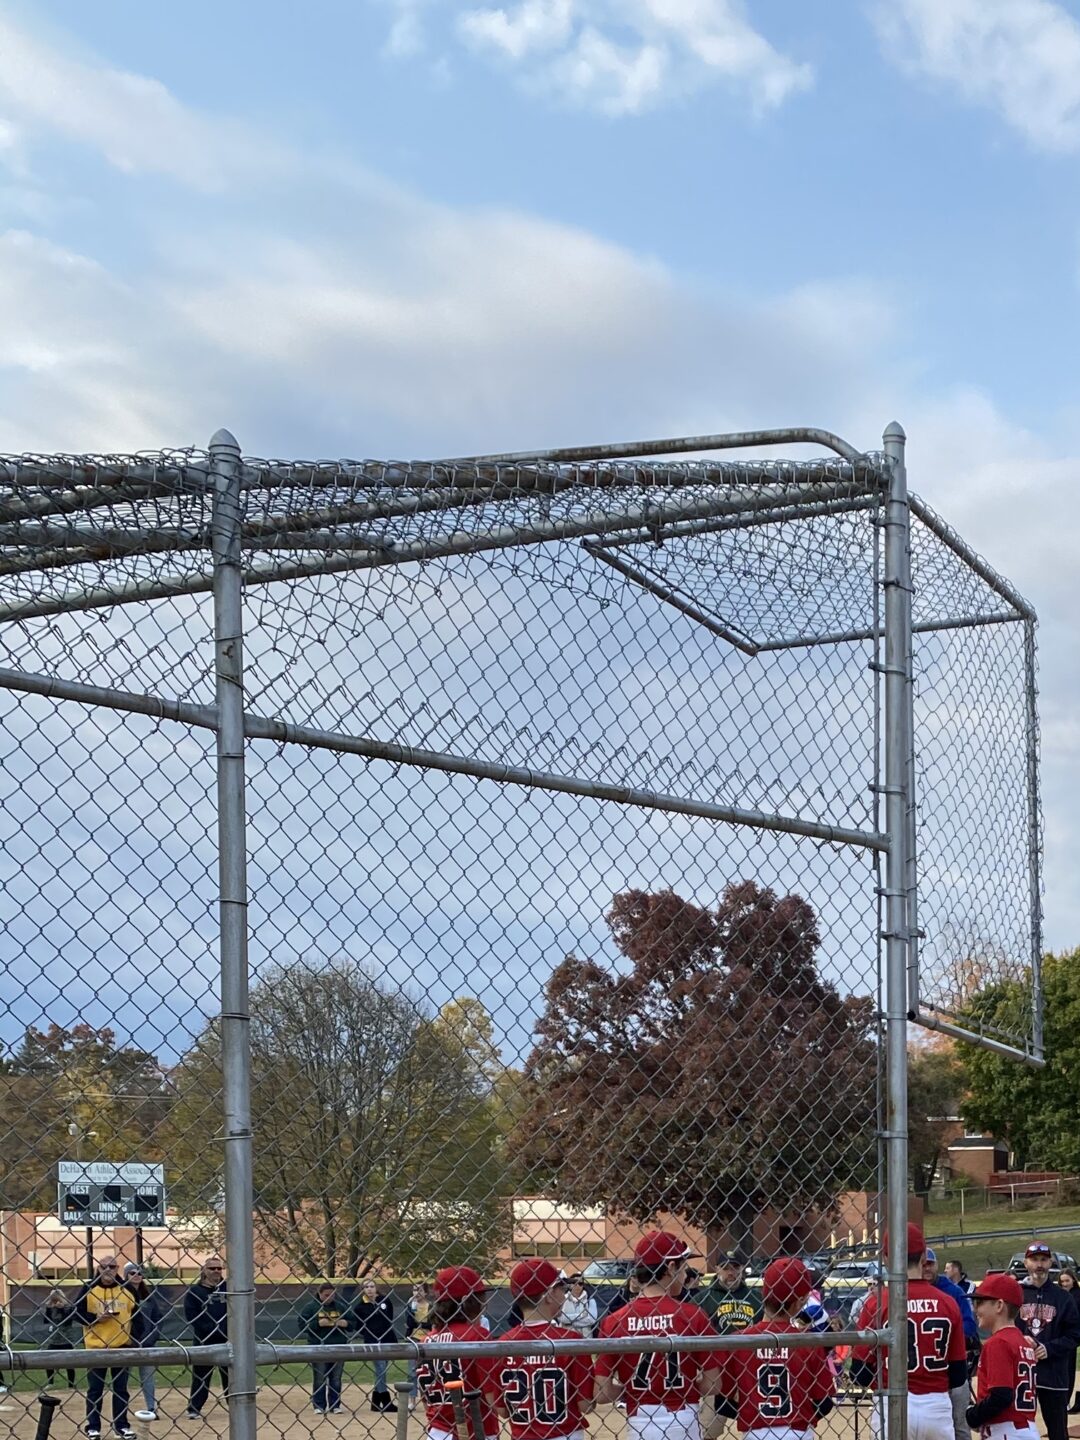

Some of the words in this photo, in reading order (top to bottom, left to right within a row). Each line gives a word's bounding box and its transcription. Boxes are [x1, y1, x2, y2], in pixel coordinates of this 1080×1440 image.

[60, 1163, 92, 1174] DeHan
[95, 1164, 121, 1175] Athlet
[124, 1166, 161, 1176] Associaon
[65, 1185, 90, 1195] UEST
[63, 1211, 83, 1221] BALL
[90, 1212, 118, 1222] STRIKE
[124, 1213, 140, 1222] OUT
[906, 1299, 939, 1314] OKEY
[627, 1313, 674, 1332] HAUGHT
[620, 1335, 685, 1391] 71
[500, 1367, 568, 1426] 20
[756, 1363, 793, 1419] 9
